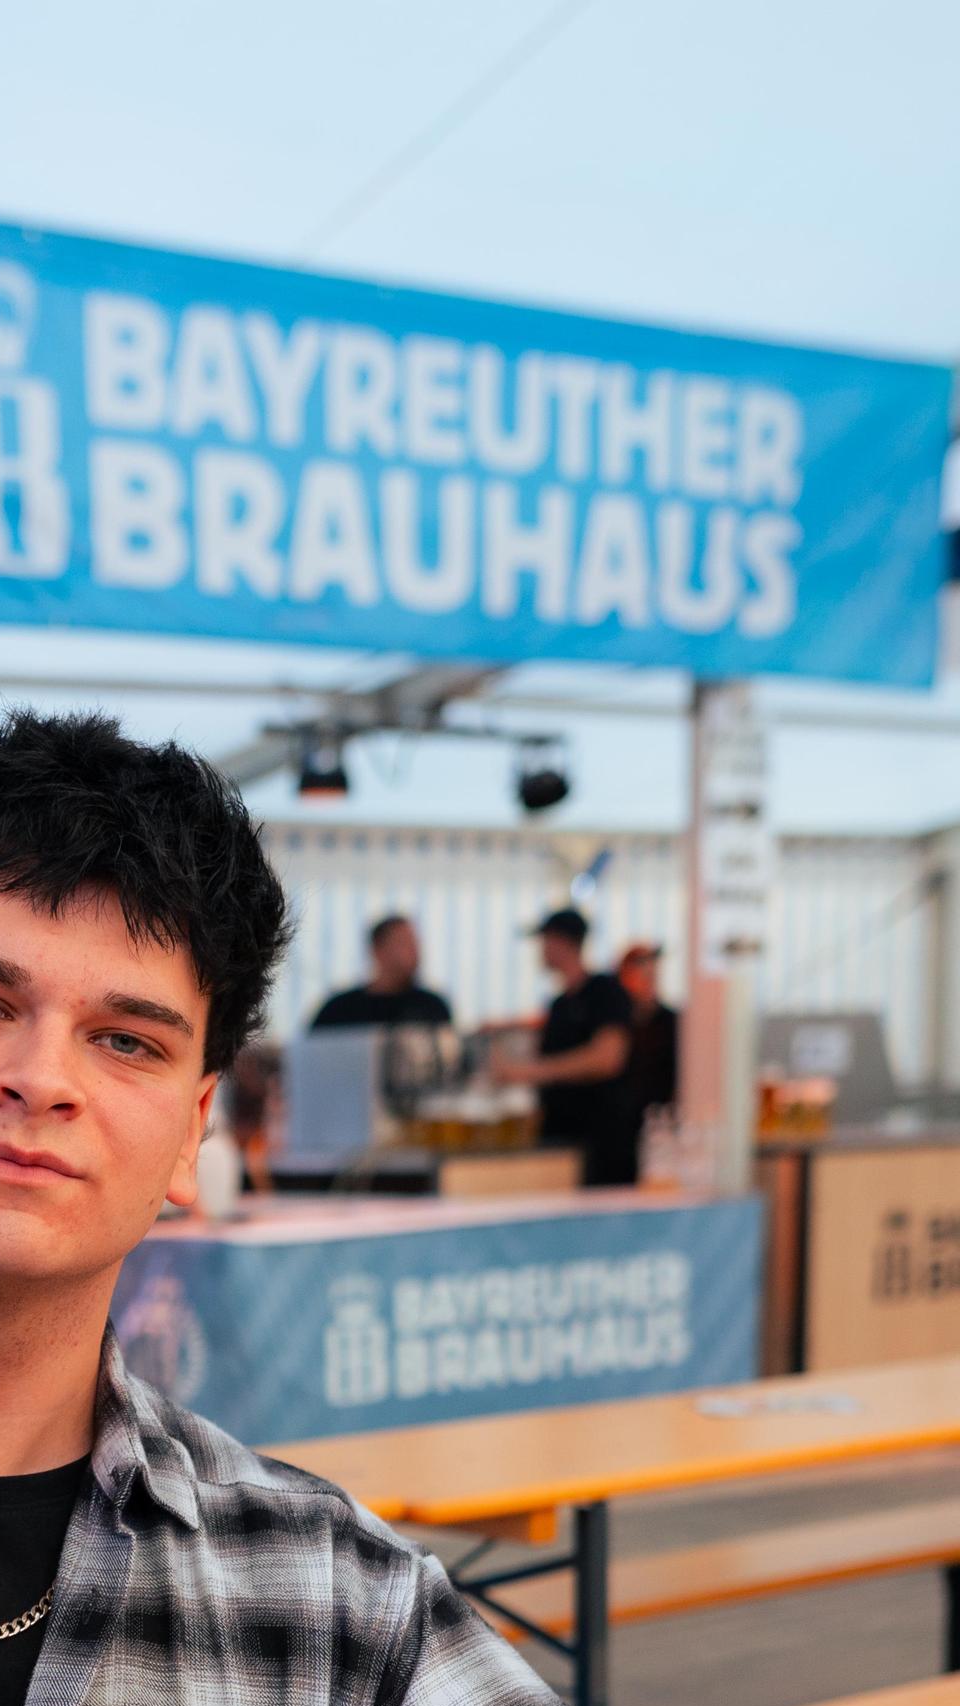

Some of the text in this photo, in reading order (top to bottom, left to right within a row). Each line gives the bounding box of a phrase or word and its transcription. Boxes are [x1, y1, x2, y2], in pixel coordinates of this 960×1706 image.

[85, 293, 803, 506] BAYREUTHER
[90, 439, 802, 637] BRAUHAUS
[394, 1253, 690, 1331] BAYREUTHER
[396, 1312, 691, 1398] BRAUHAUS
